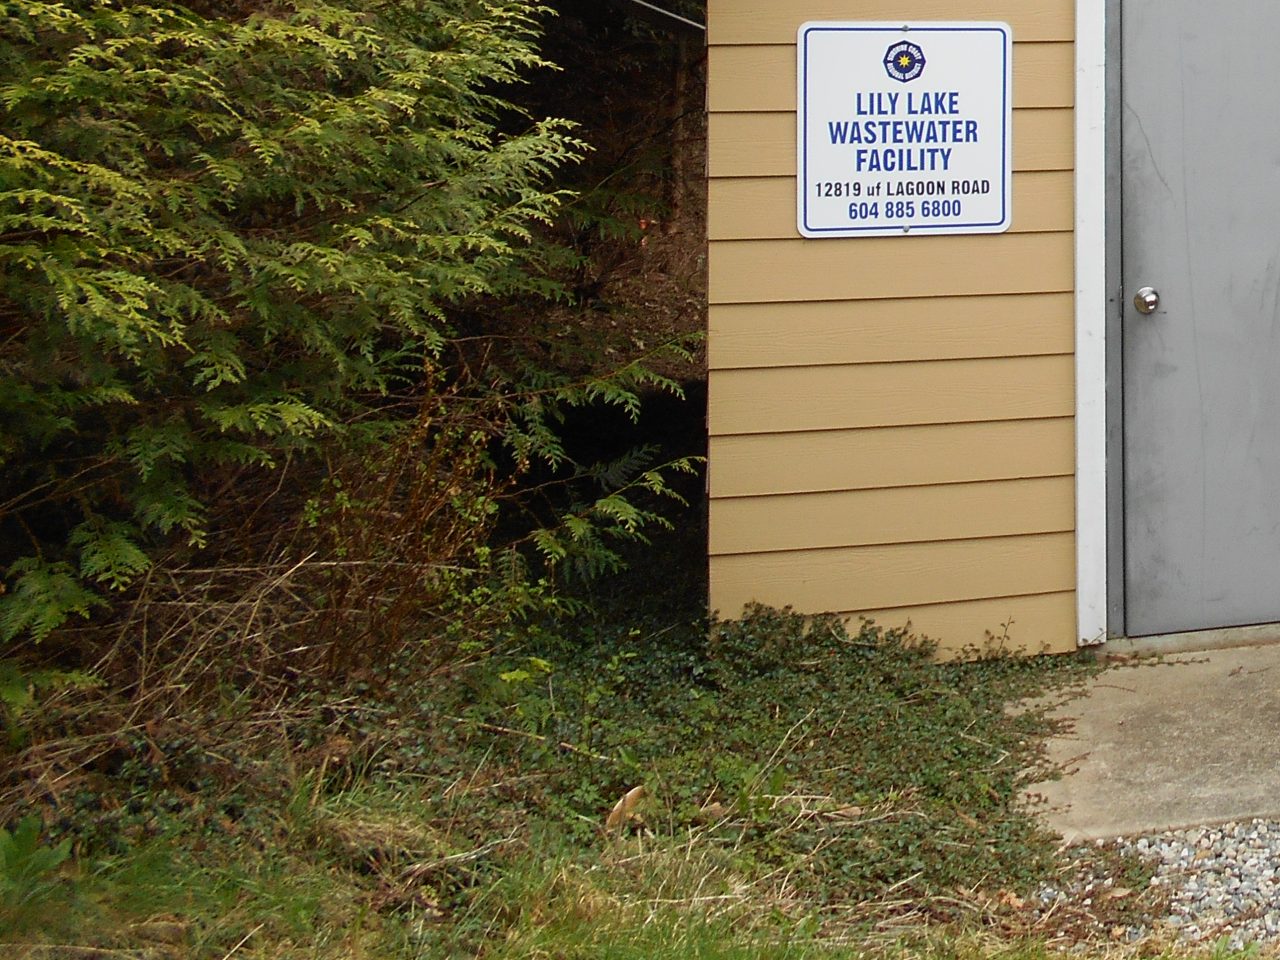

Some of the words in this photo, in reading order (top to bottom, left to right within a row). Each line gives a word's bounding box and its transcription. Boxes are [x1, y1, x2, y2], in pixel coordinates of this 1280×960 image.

[857, 93, 899, 115] LILY
[908, 92, 959, 115] LAKE
[829, 121, 978, 144] WASTEWATER
[857, 148, 952, 172] FACILITY
[816, 182, 861, 197] 12819
[887, 181, 945, 196] LAGOON
[952, 180, 989, 195] ROAD
[849, 202, 879, 219] 604
[885, 201, 914, 219] 885
[922, 200, 961, 218] 6800
